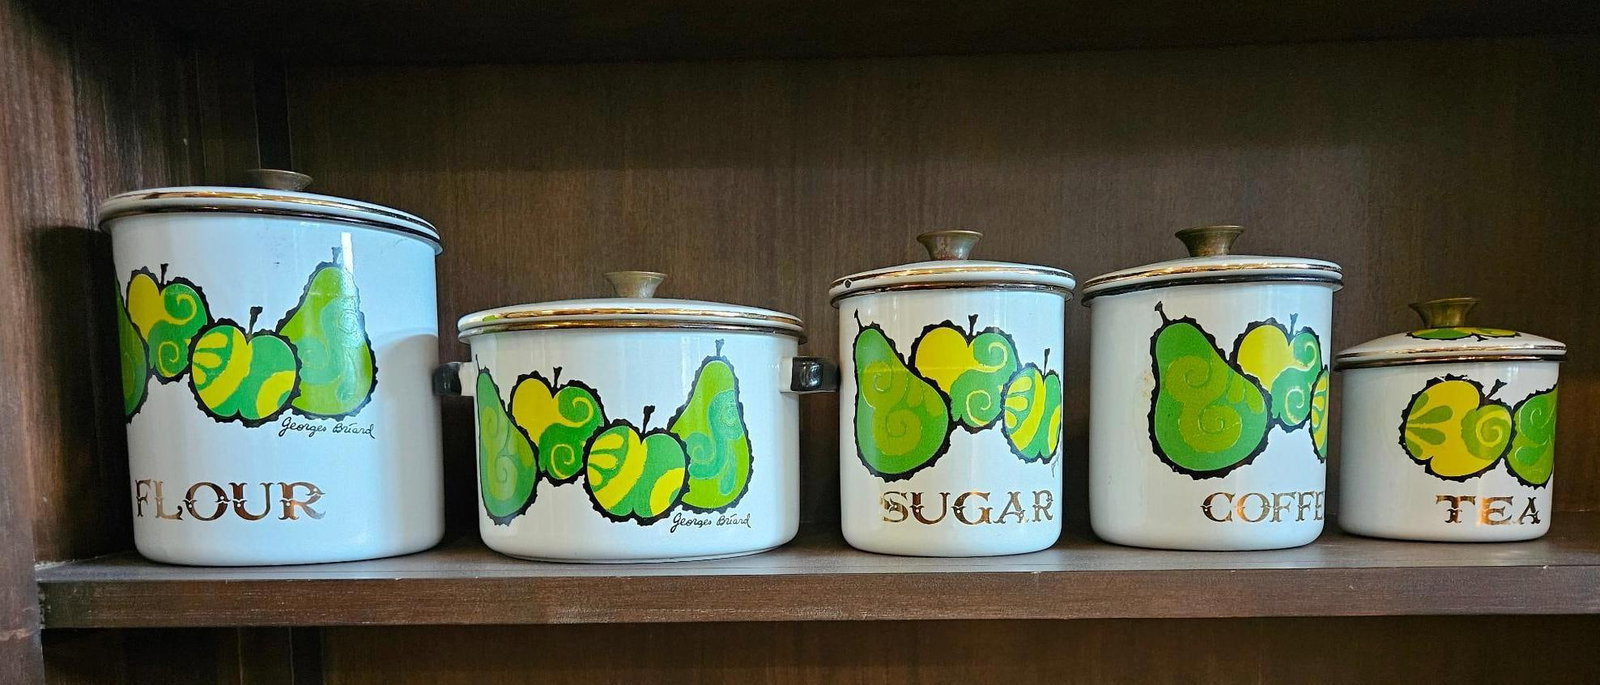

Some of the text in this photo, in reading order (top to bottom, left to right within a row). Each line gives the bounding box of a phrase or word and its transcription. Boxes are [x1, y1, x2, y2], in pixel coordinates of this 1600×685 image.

[278, 416, 327, 438] Georges
[135, 479, 326, 521] FLOUR
[880, 488, 1054, 525] SUGAR
[1435, 495, 1541, 526] TEA
[669, 512, 712, 533] Georges
